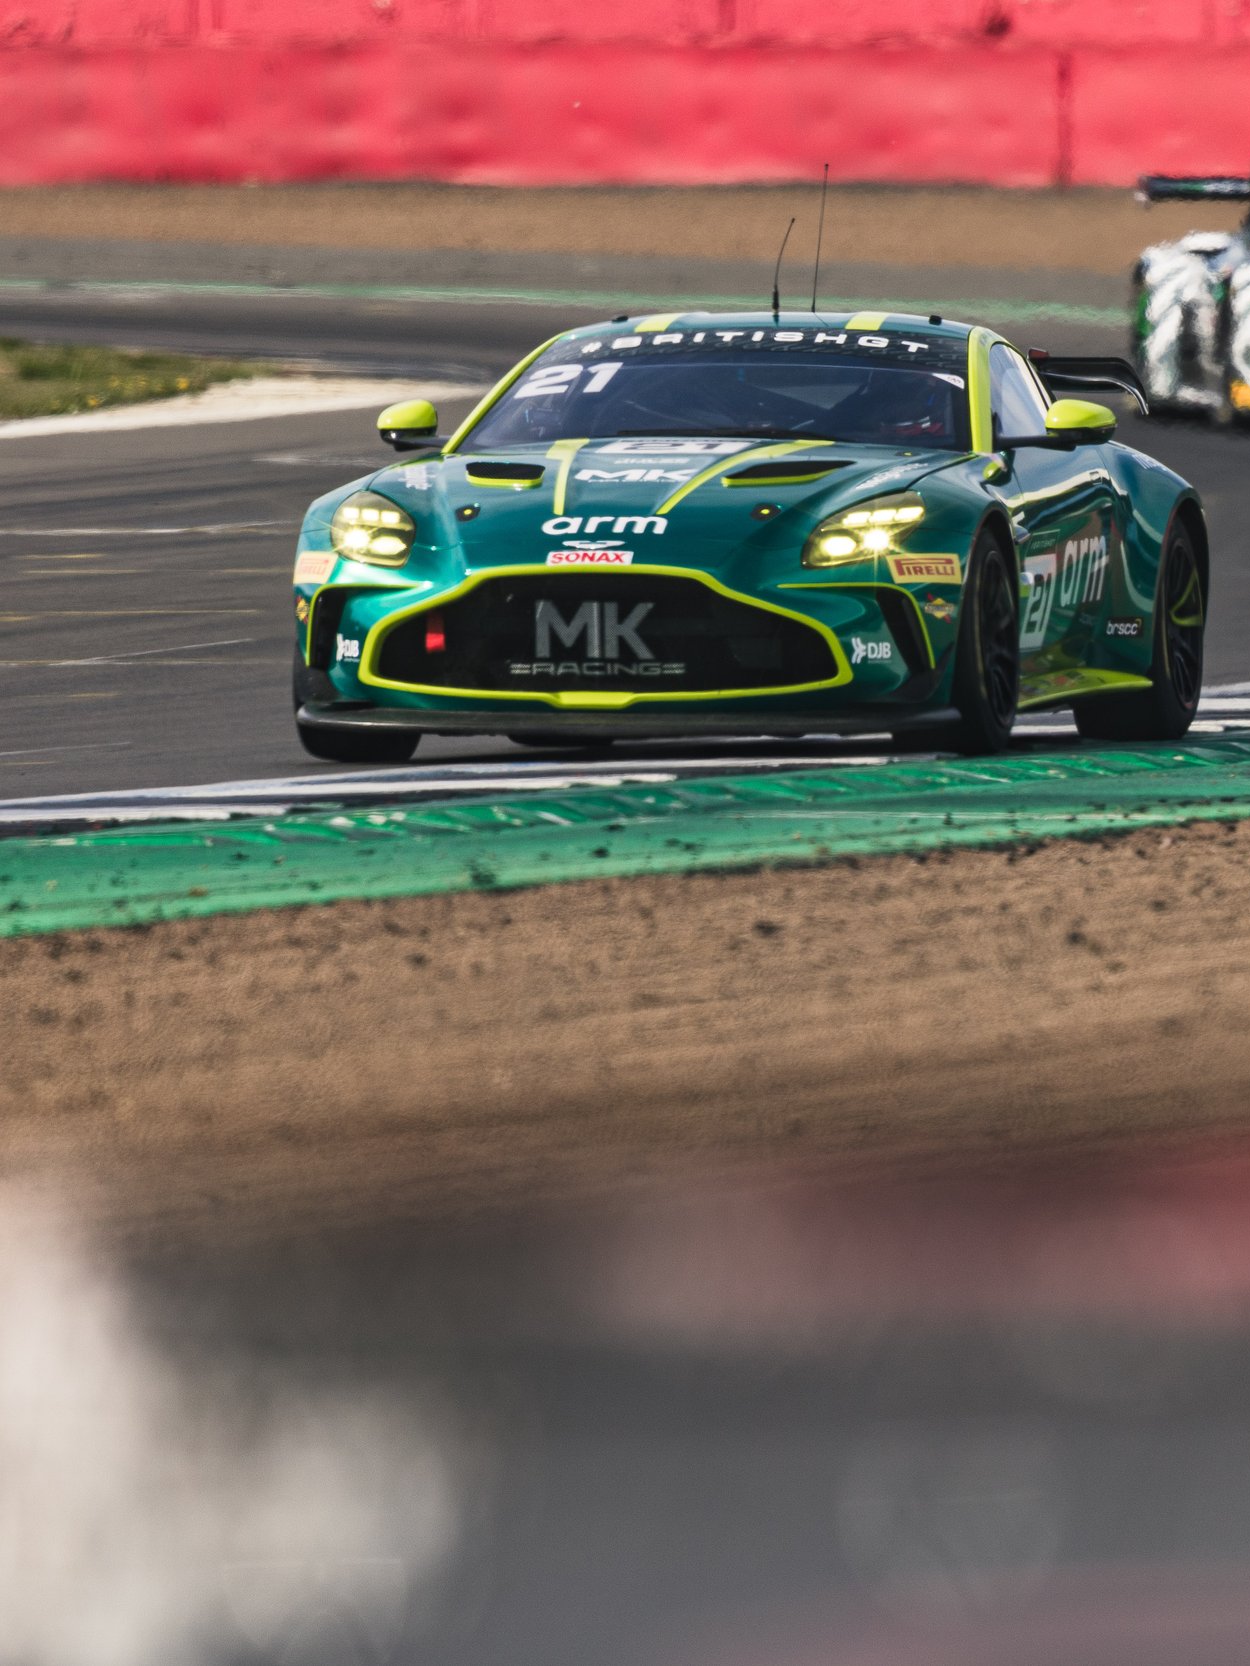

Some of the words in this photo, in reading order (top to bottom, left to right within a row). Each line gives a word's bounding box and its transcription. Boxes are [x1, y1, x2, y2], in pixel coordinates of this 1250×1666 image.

[582, 331, 929, 354] #BRITISHGT
[513, 361, 624, 399] 21
[575, 468, 699, 481] MK
[541, 516, 668, 535] arm
[550, 551, 626, 564] SONAX
[894, 558, 955, 577] PIRELLI
[1060, 534, 1107, 608] arm
[535, 600, 656, 660] MK
[1106, 621, 1138, 635] brscc
[867, 642, 892, 659] DJB
[532, 662, 663, 676] RACING
